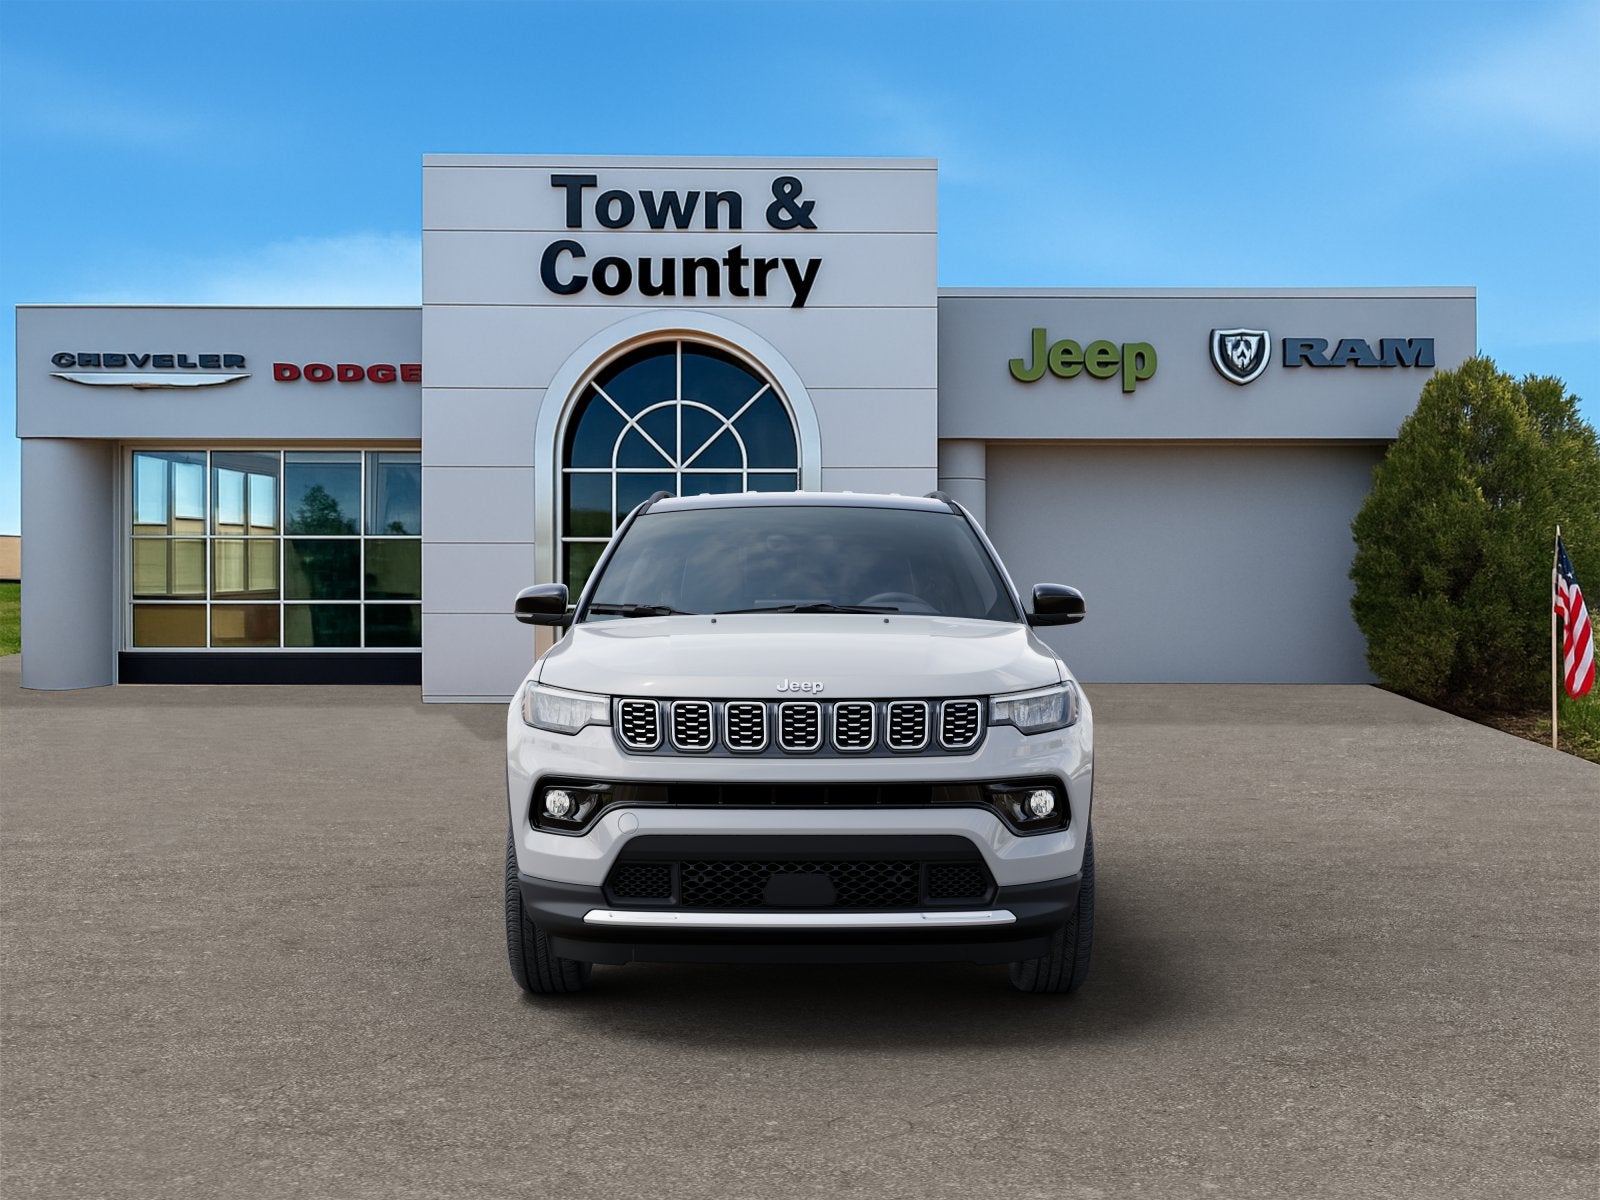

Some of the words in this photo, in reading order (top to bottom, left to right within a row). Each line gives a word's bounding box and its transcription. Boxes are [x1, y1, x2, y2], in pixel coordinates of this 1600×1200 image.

[551, 174, 742, 229] Town
[766, 176, 818, 229] &
[540, 240, 822, 308] Country
[273, 362, 422, 383] DODGE
[1009, 328, 1158, 393] Jeep
[1283, 338, 1435, 368] RAM
[776, 678, 824, 695] Jeep
